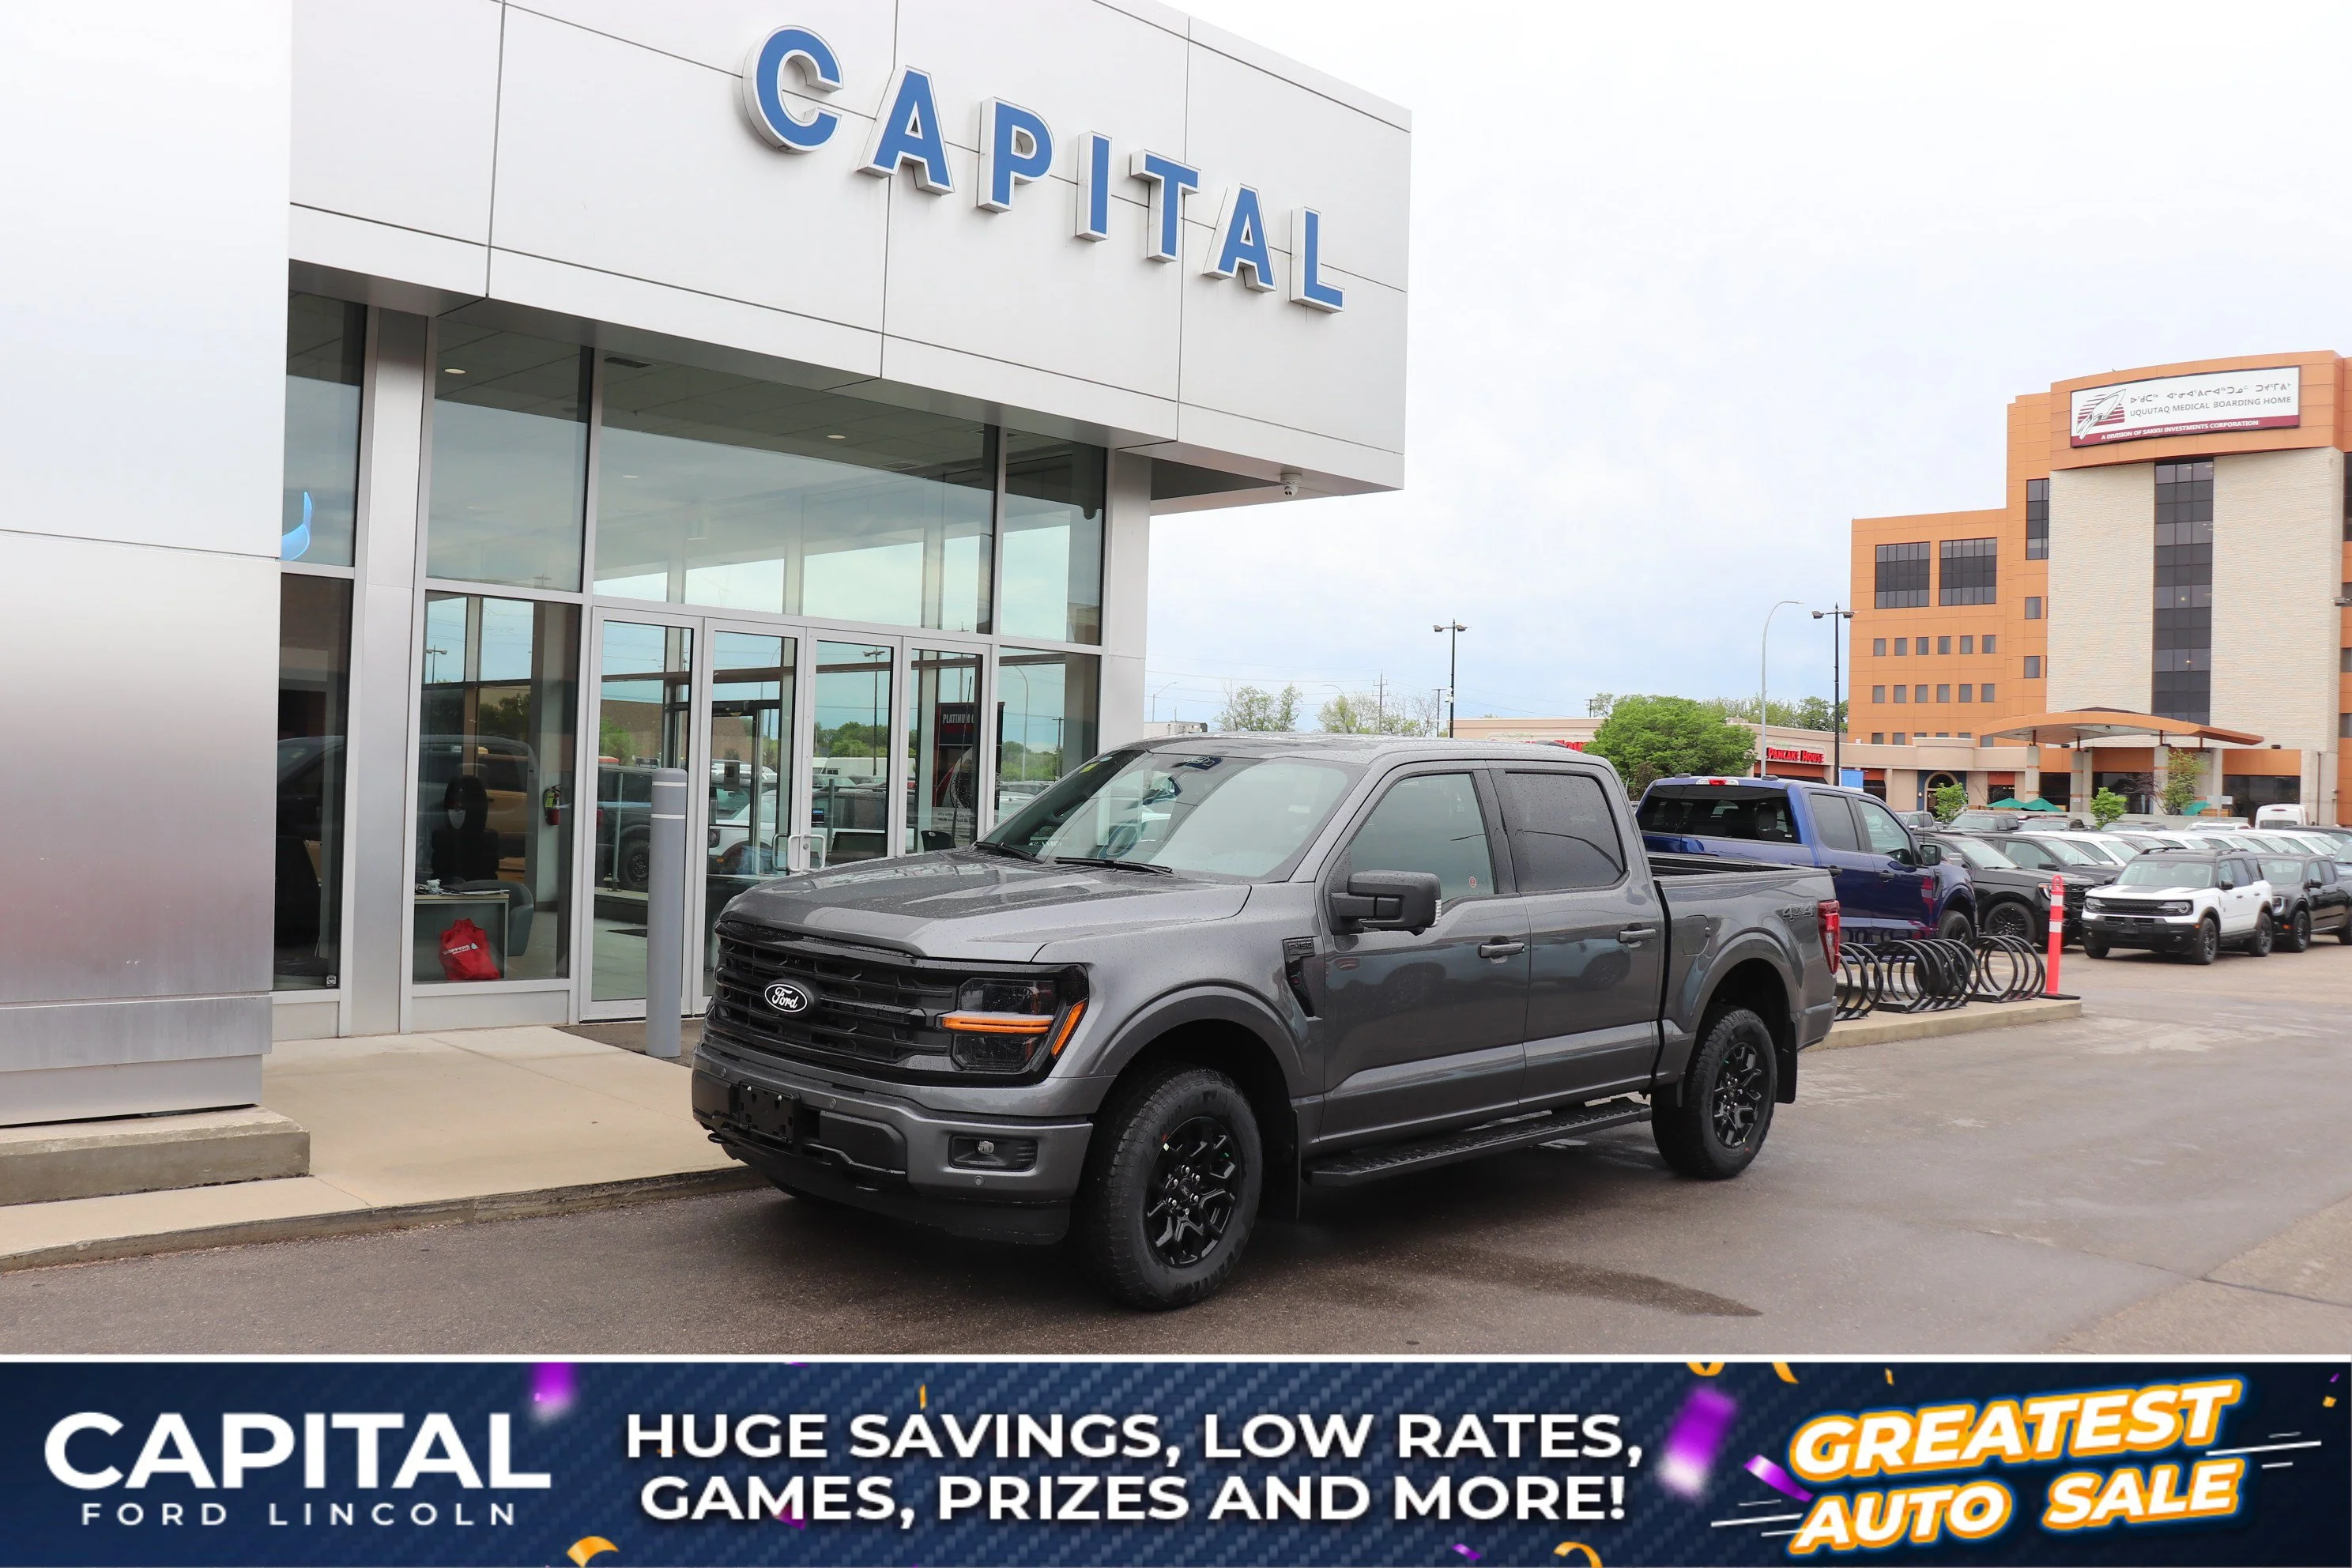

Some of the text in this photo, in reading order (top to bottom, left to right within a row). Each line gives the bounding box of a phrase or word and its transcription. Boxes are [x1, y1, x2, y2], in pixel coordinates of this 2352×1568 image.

[742, 24, 1345, 313] CAPITAL
[2130, 396, 2291, 416] UQUUTAQ MEDICAL BOARDING HOME
[2106, 431, 2133, 439] DIVISION
[2164, 423, 2208, 432] INVESTMENTS
[2209, 420, 2260, 428] CORPORATION
[1766, 747, 1824, 763] PANCAKE HOUSE
[772, 986, 799, 1009] Ford
